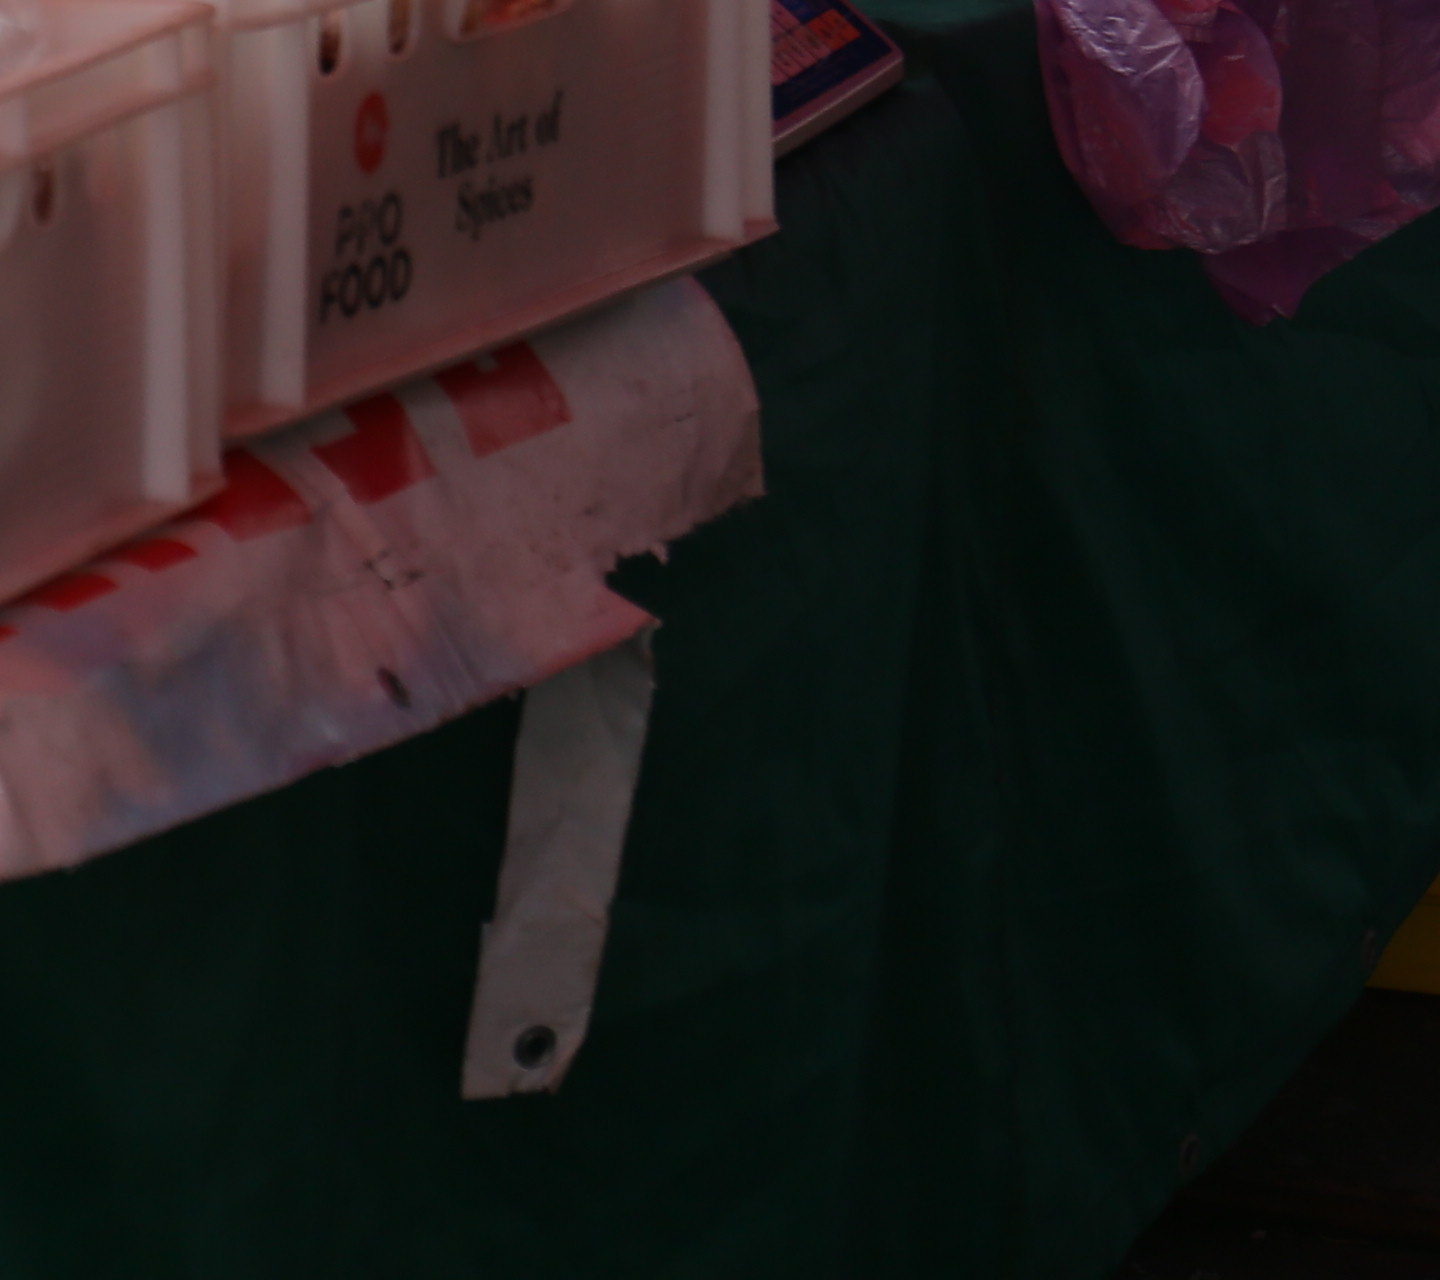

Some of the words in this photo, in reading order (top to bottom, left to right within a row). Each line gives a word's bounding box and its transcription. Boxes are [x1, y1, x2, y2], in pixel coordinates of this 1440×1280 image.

[435, 120, 480, 178] The
[484, 111, 528, 163] Art
[534, 88, 564, 147] of
[454, 176, 536, 242] Spices
[319, 247, 412, 324] FOOD
